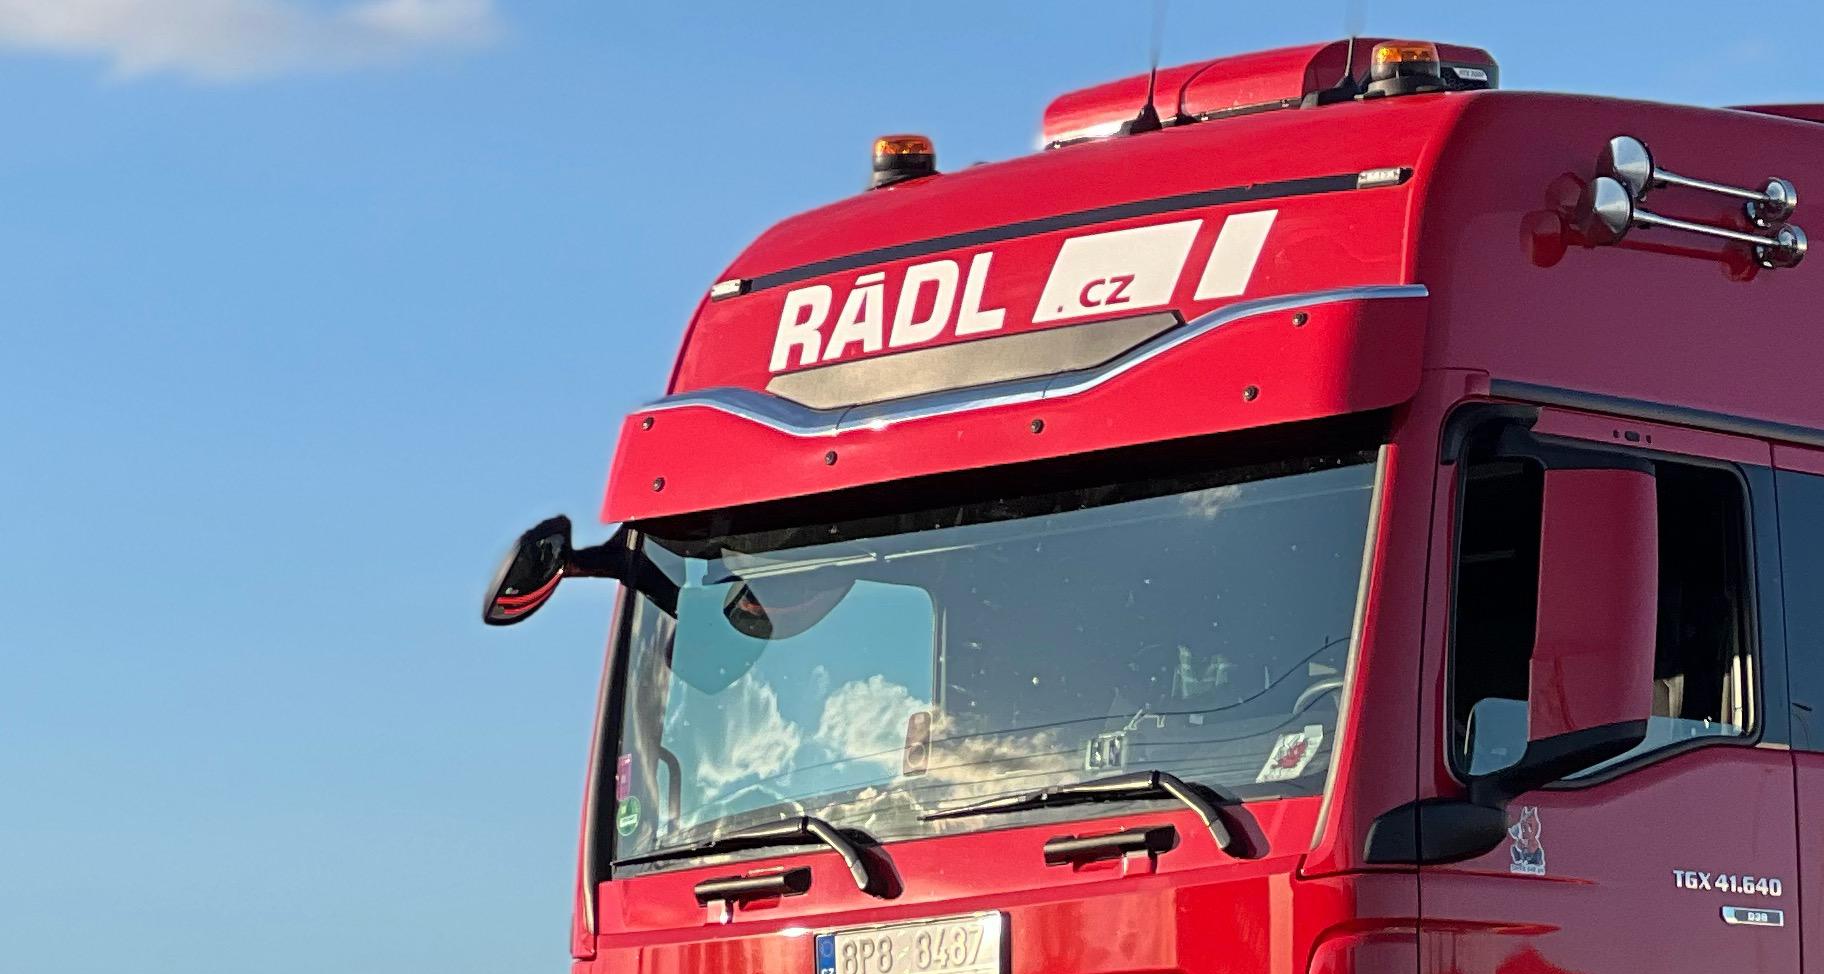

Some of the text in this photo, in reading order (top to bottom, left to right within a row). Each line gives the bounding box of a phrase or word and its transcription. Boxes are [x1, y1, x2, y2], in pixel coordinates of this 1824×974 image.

[1672, 869, 1782, 897] TGX 41.640
[915, 926, 985, 970] 8487
